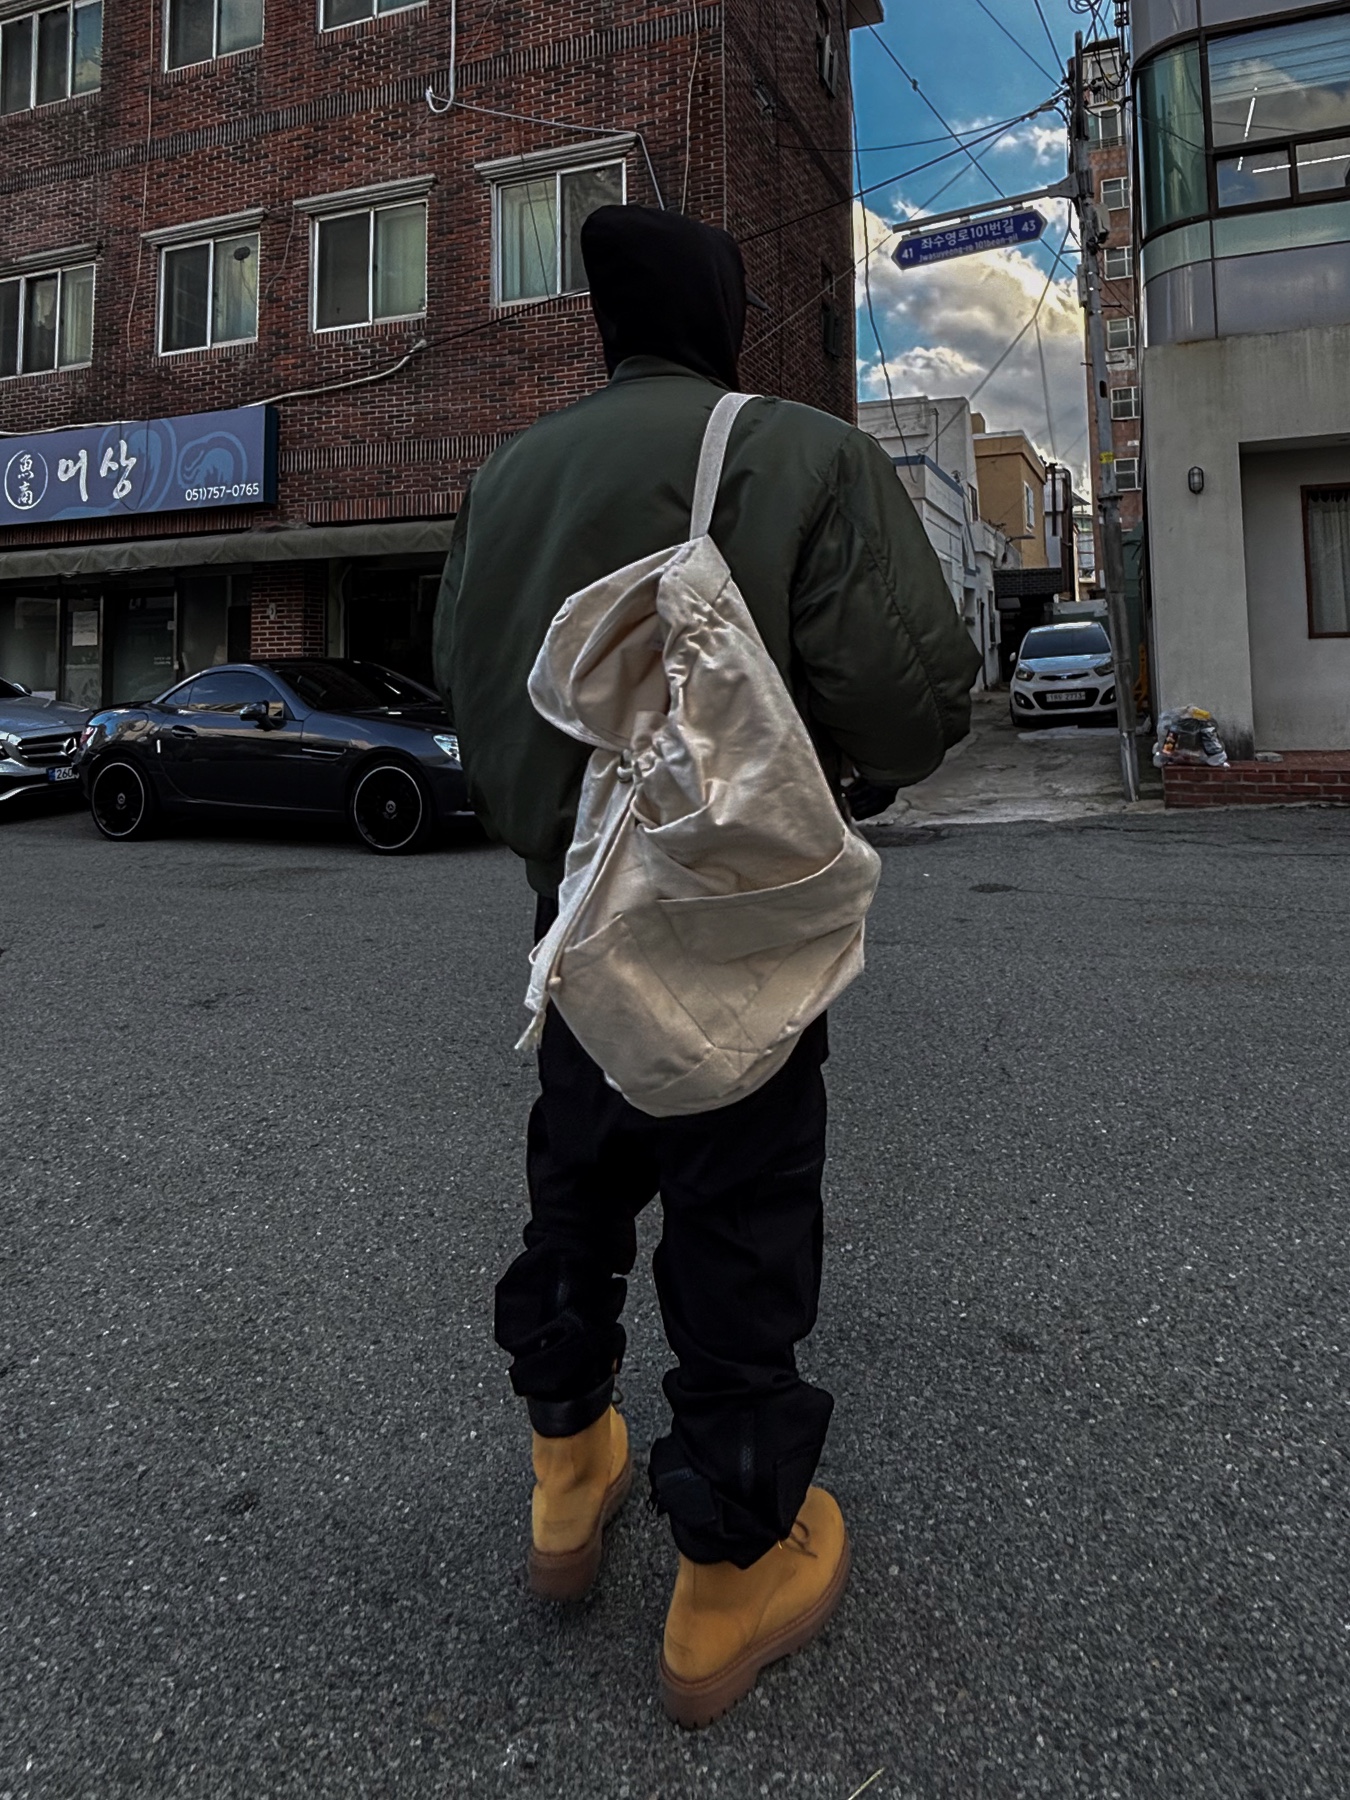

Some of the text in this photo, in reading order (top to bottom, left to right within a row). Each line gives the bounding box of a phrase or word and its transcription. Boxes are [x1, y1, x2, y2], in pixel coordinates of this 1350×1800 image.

[921, 218, 1014, 249] 좌수영로101번길
[1021, 220, 1036, 232] 43
[901, 248, 914, 259] 41
[919, 244, 974, 263] Jwasuyeong-ro
[57, 439, 137, 502] 어상
[185, 482, 259, 502] 051)757-0765
